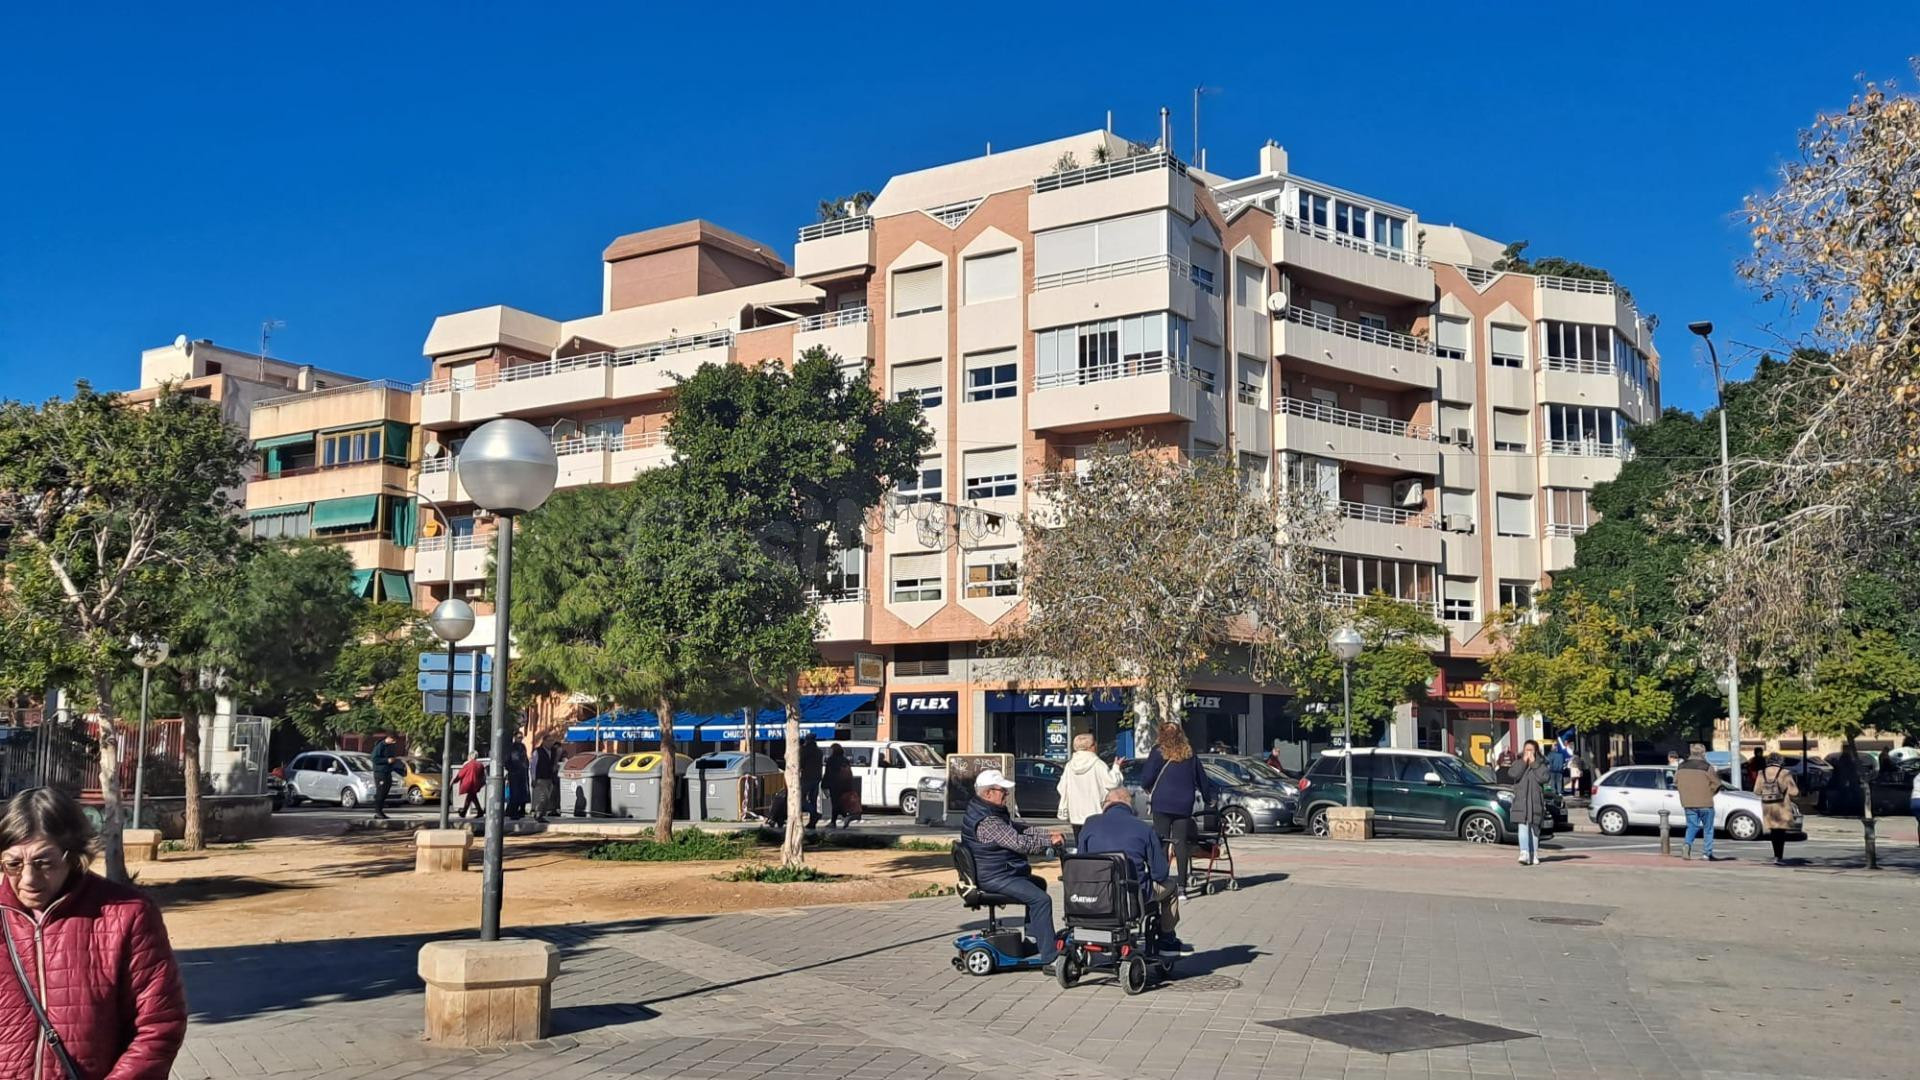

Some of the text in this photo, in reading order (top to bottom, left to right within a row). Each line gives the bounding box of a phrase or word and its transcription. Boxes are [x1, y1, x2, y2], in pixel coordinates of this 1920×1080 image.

[910, 697, 951, 710] FLEX
[1043, 694, 1087, 707] FLEX
[602, 731, 615, 739] BAR
